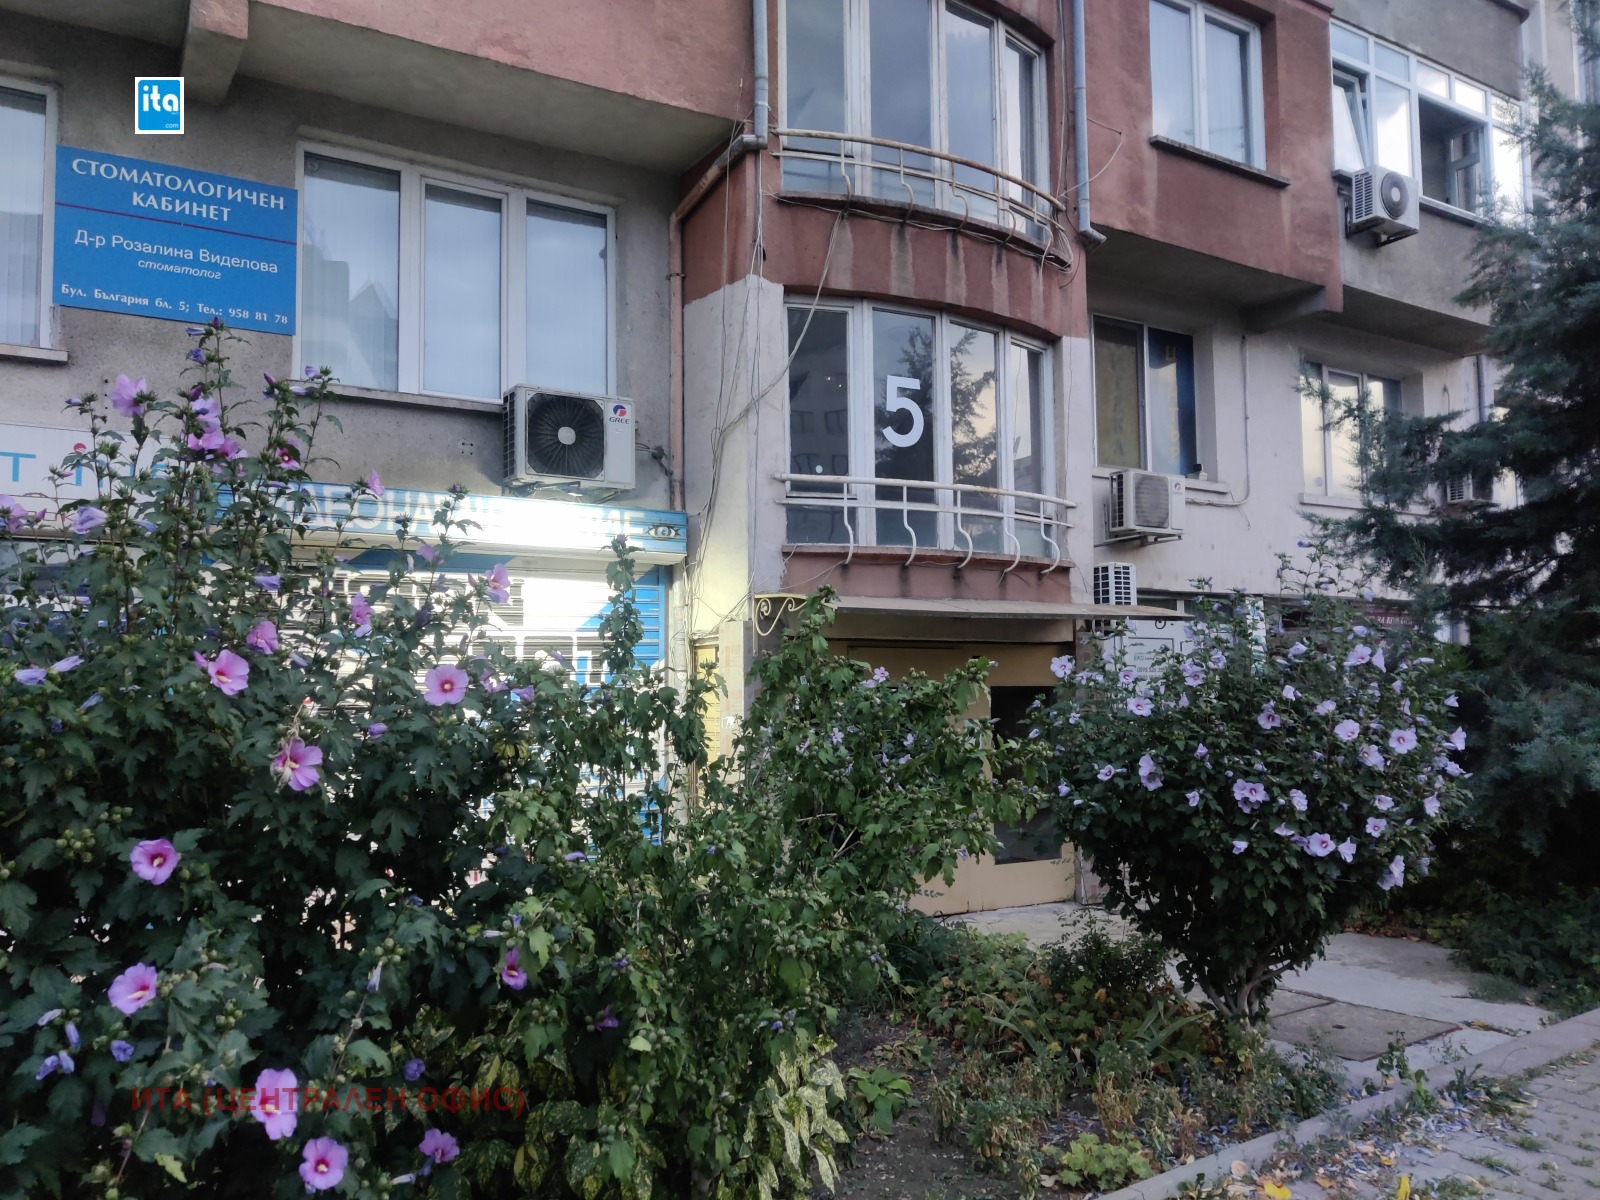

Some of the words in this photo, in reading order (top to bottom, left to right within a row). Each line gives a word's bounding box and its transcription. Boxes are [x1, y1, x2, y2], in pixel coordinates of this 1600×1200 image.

[72, 158, 285, 210] СТОМАТОЛОГИЧЕН
[132, 191, 231, 222] КАБИНЕТ
[74, 229, 106, 248] Д-р
[111, 235, 194, 260] Розалина
[199, 249, 278, 274] Виделова
[137, 259, 222, 280] стоматолог
[61, 283, 87, 297] Бул.
[94, 289, 149, 306] България
[155, 297, 172, 309] бл.
[228, 307, 249, 319] 958
[255, 311, 268, 322] 81
[274, 314, 288, 325] 78
[882, 374, 925, 448] 5
